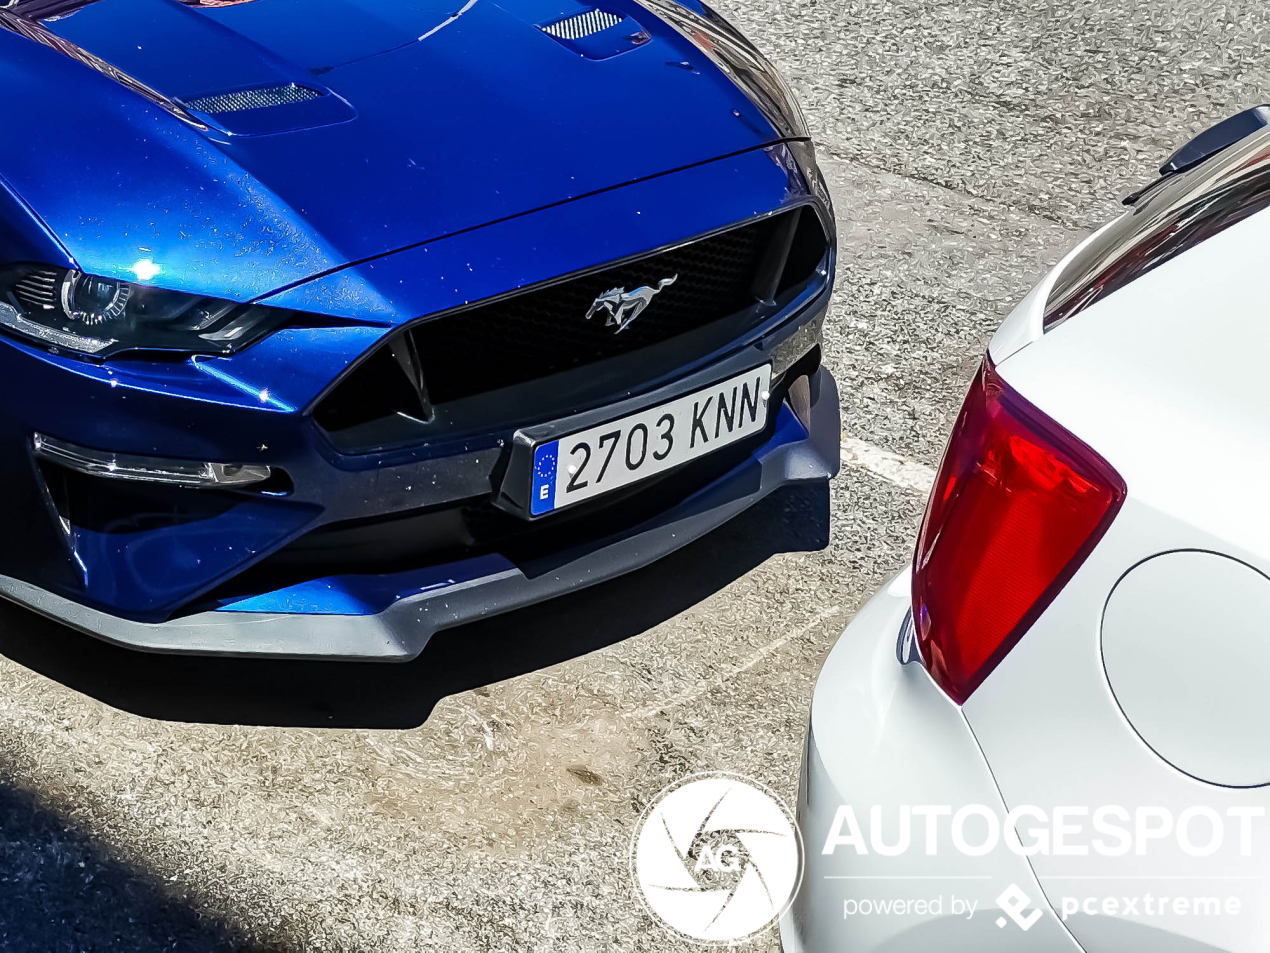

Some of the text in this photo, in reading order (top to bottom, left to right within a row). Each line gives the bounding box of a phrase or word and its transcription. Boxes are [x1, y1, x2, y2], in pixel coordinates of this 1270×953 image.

[566, 377, 761, 494] 2703 KNN
[539, 485, 549, 500] E
